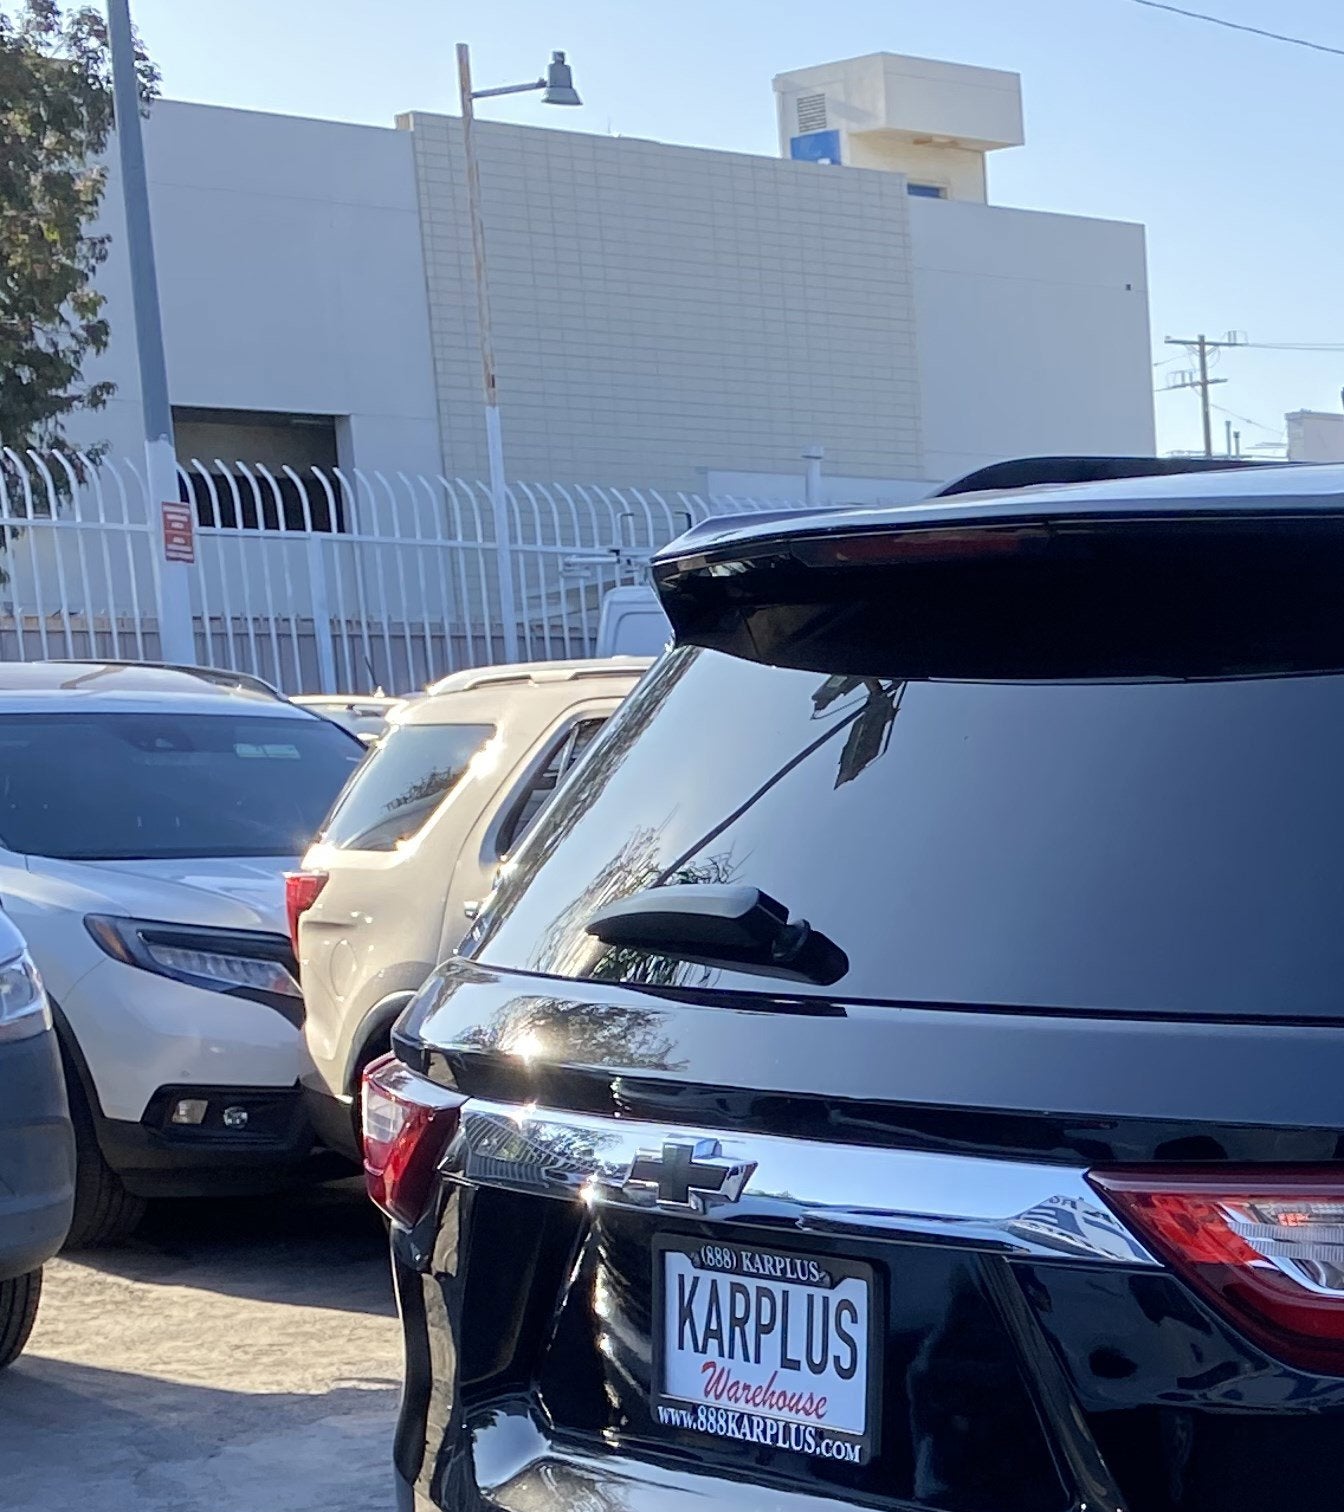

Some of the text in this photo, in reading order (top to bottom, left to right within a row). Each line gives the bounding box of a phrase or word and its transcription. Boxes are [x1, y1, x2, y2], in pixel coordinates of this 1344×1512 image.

[701, 1246, 820, 1282] (888) KARPLUS
[678, 1273, 858, 1380] KARPLUS
[701, 1361, 827, 1420] Warehouse
